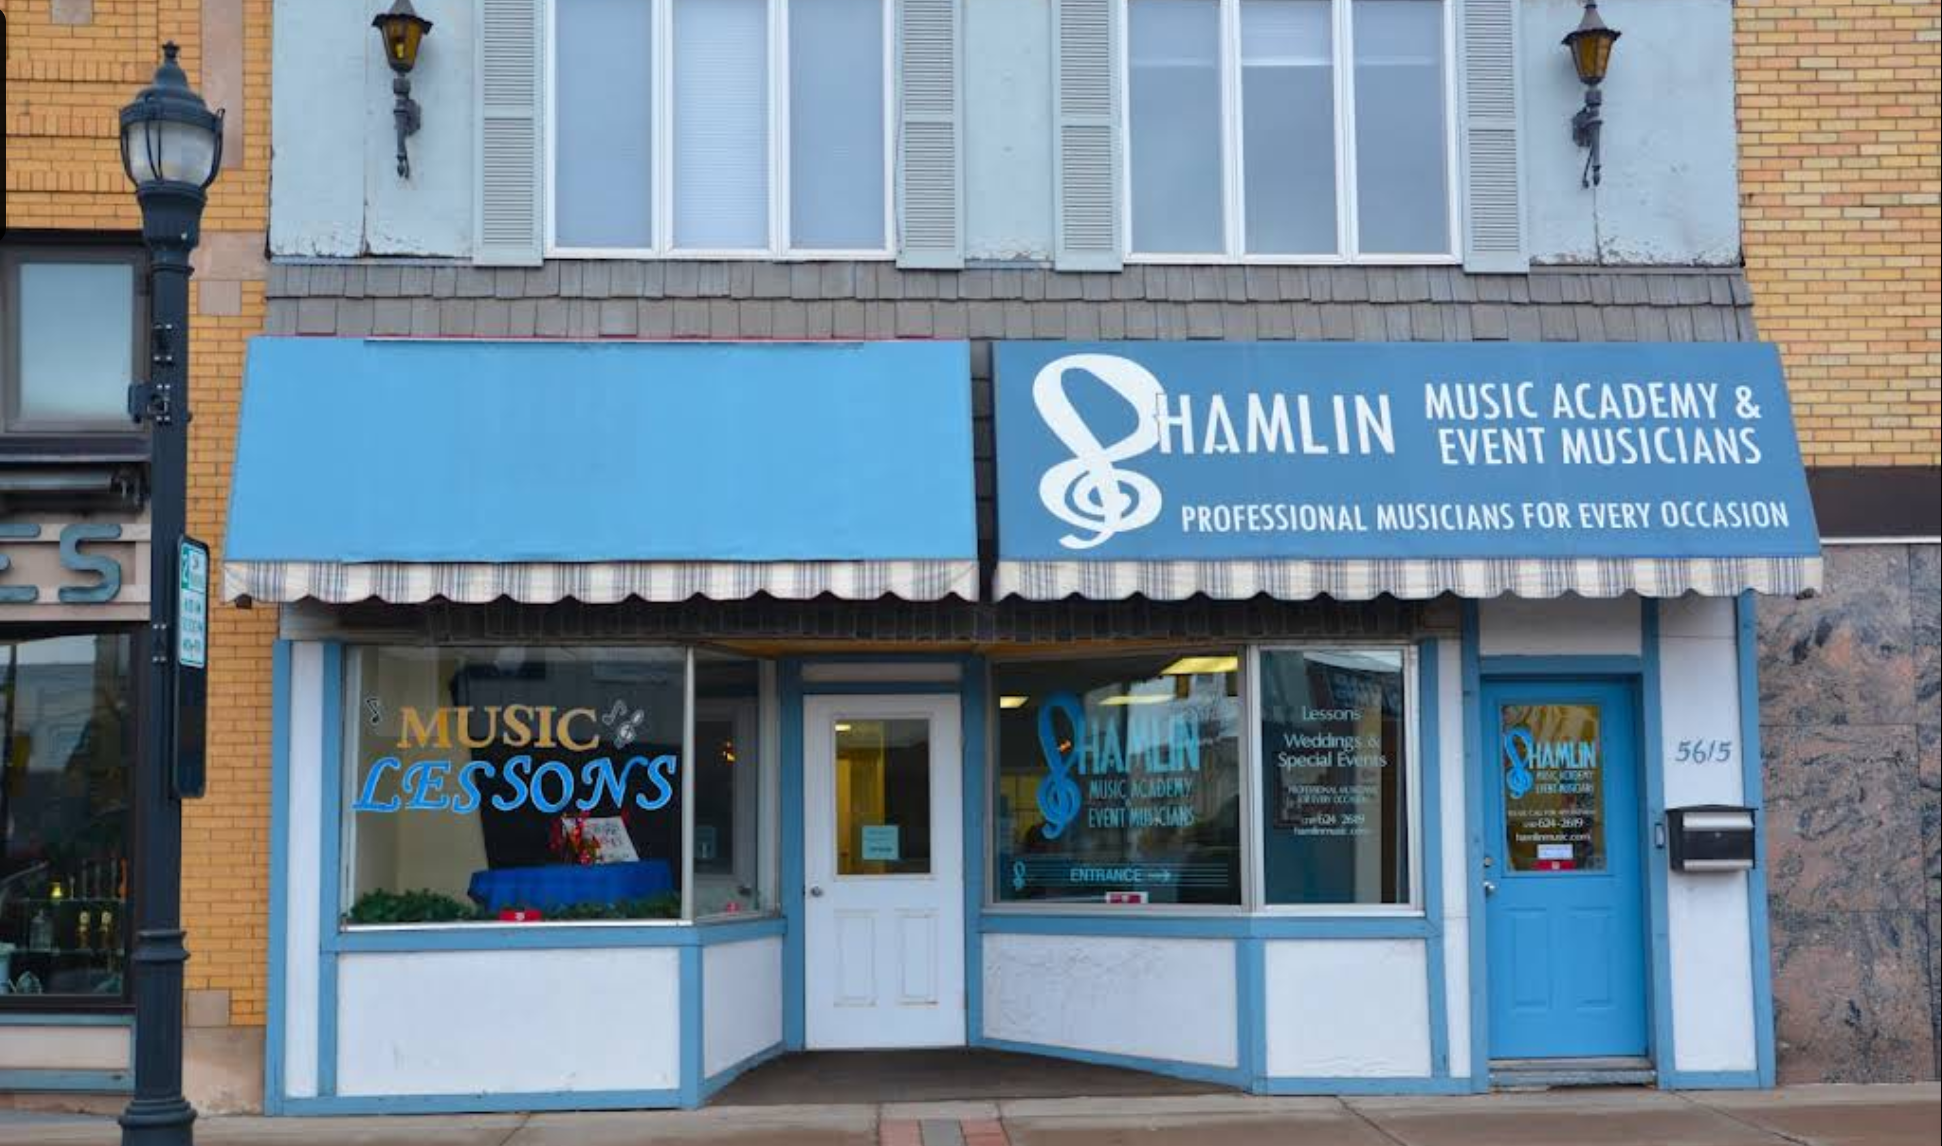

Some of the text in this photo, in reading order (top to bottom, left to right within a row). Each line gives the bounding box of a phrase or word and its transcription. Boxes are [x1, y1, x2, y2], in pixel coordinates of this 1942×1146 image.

[1424, 381, 1762, 420] MUSIC ACADEMY &
[1156, 393, 1395, 455] HAMLIN
[1439, 426, 1762, 465] EVENT MUSICIANS
[1182, 500, 1790, 532] PROFESSIONAL MUSICIANS FOR EVERY OCCASION
[1302, 705, 1361, 720] Lessons
[397, 704, 599, 751] MUSIC
[1078, 713, 1200, 775] HAMLIN
[1283, 732, 1380, 753] Weddings &
[1529, 740, 1596, 769] HAMLIN
[1675, 740, 1732, 764] 5615
[1278, 751, 1387, 771] Special Events
[352, 754, 677, 813] LESSONS
[1089, 778, 1194, 799] MUSIC ACADEMY
[1089, 806, 1195, 828] EVENT MUSICIANS
[1515, 832, 1591, 842] hamlinmusic.com
[1070, 869, 1142, 882] ENTRANCE
